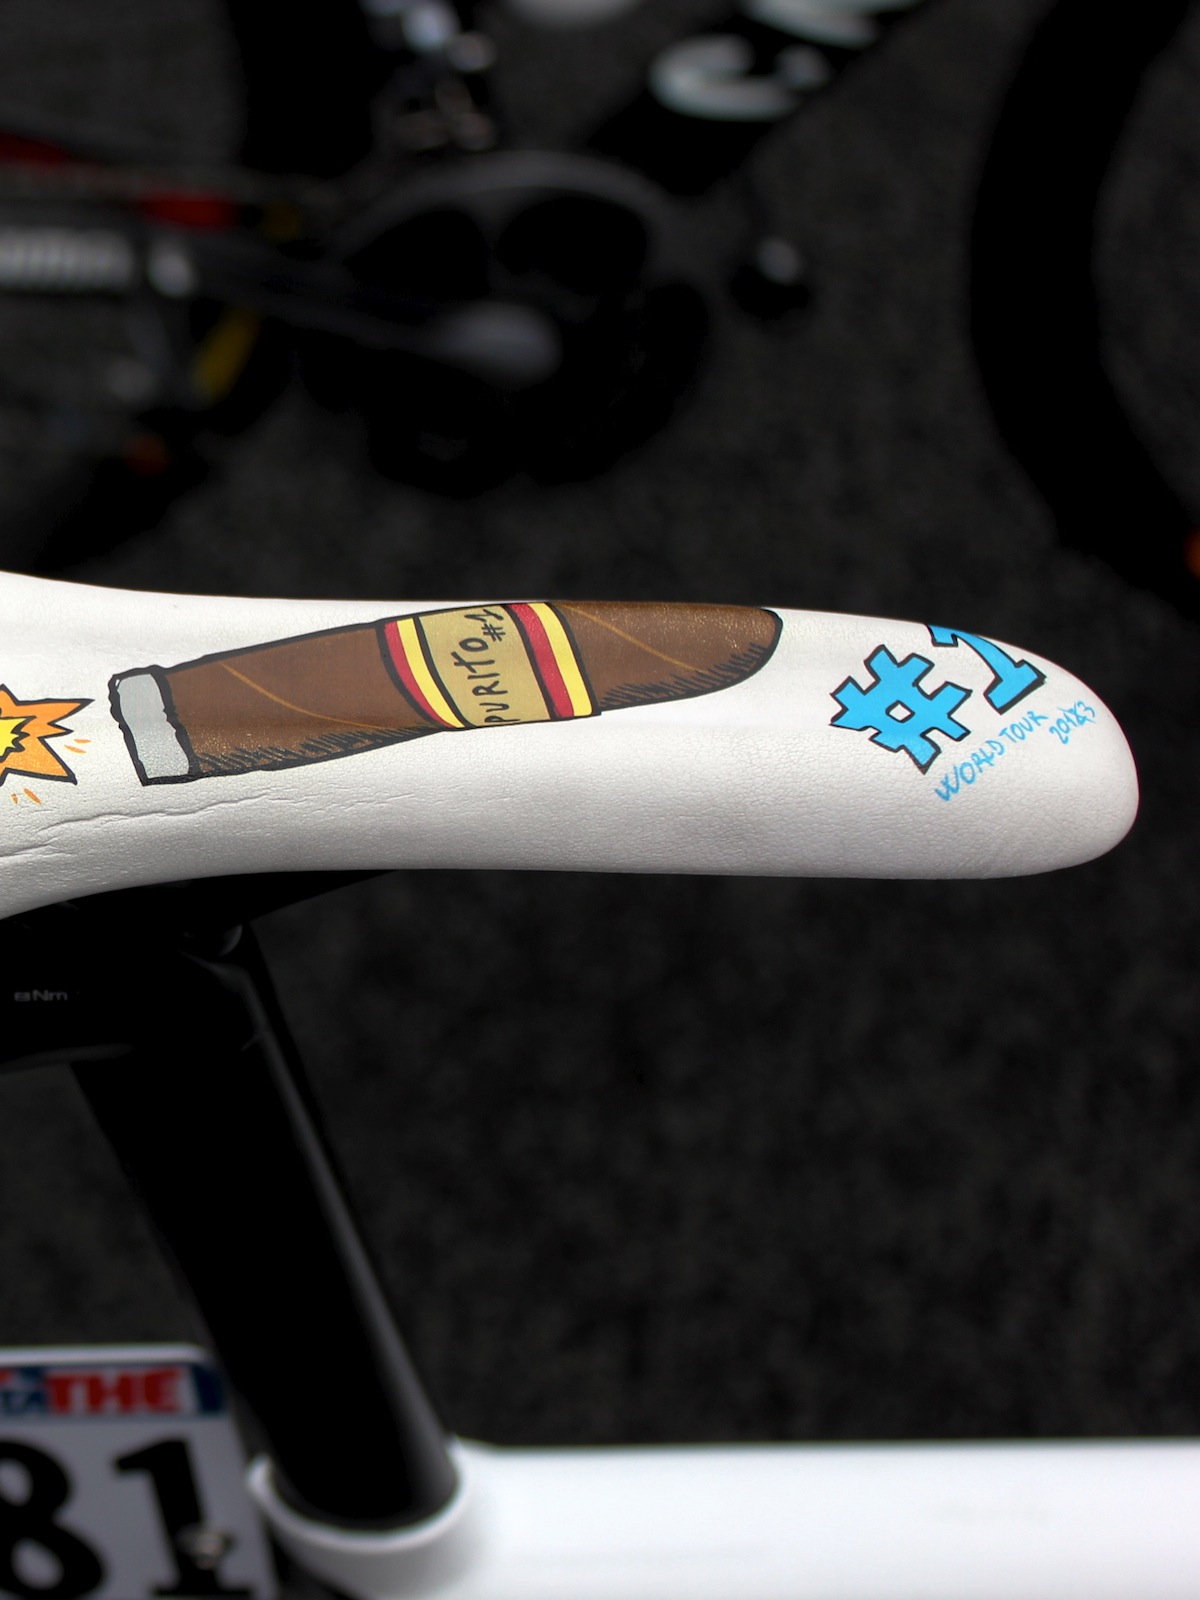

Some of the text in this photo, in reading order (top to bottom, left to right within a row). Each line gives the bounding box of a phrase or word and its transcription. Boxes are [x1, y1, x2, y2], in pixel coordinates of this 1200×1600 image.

[450, 608, 521, 724] PURITO #1
[829, 624, 1048, 776] #1
[934, 709, 1050, 802] WORLD TOUR
[45, 1364, 185, 1416] THE
